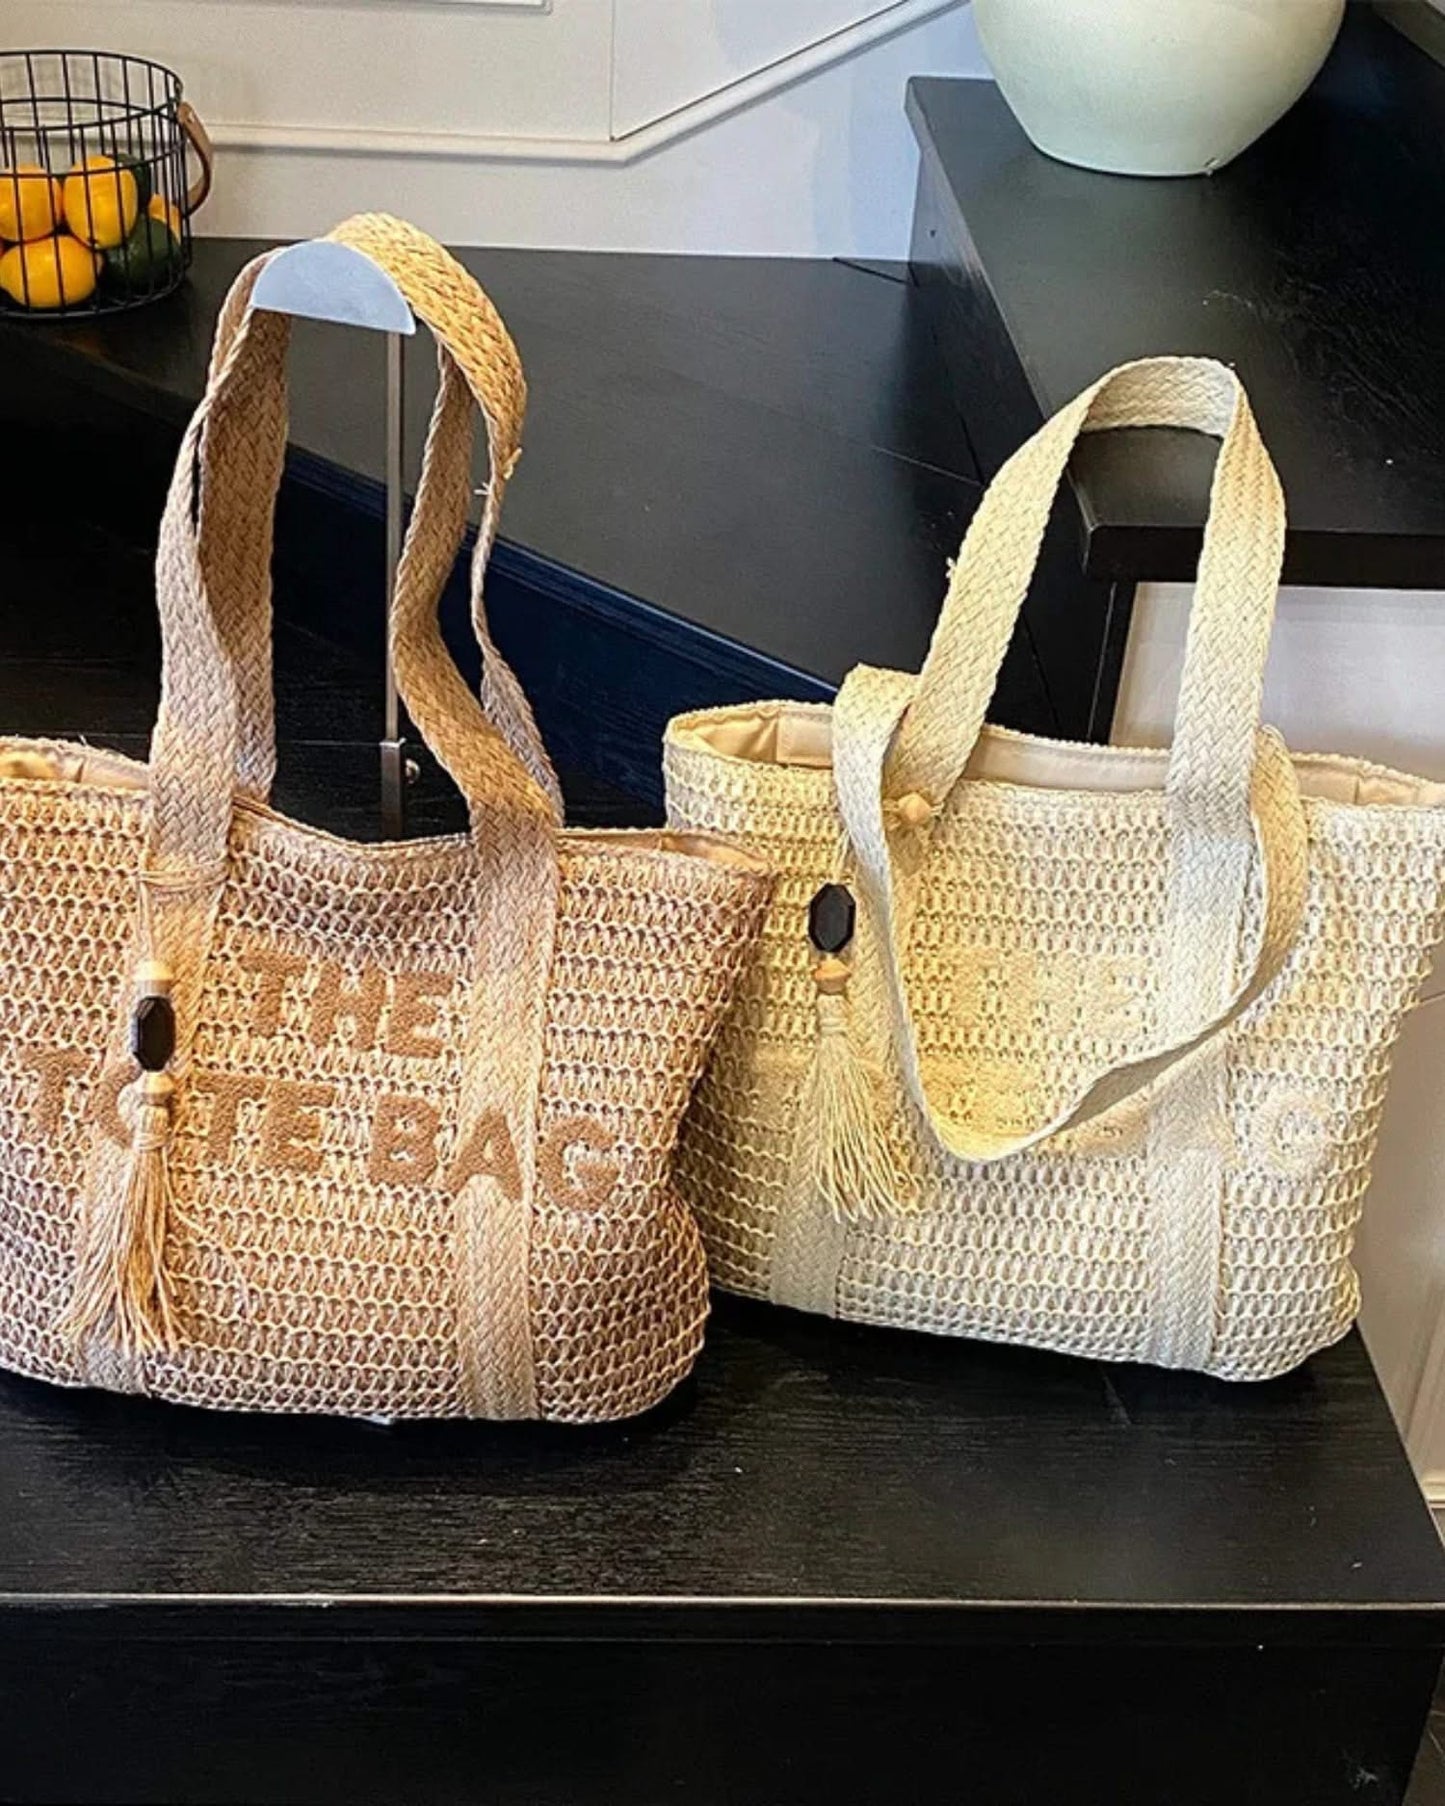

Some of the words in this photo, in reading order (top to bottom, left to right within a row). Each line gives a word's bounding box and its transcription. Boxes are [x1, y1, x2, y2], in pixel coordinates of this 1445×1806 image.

[237, 946, 455, 1059] THE
[937, 946, 1148, 1034] THE
[368, 1093, 621, 1211] BAG
